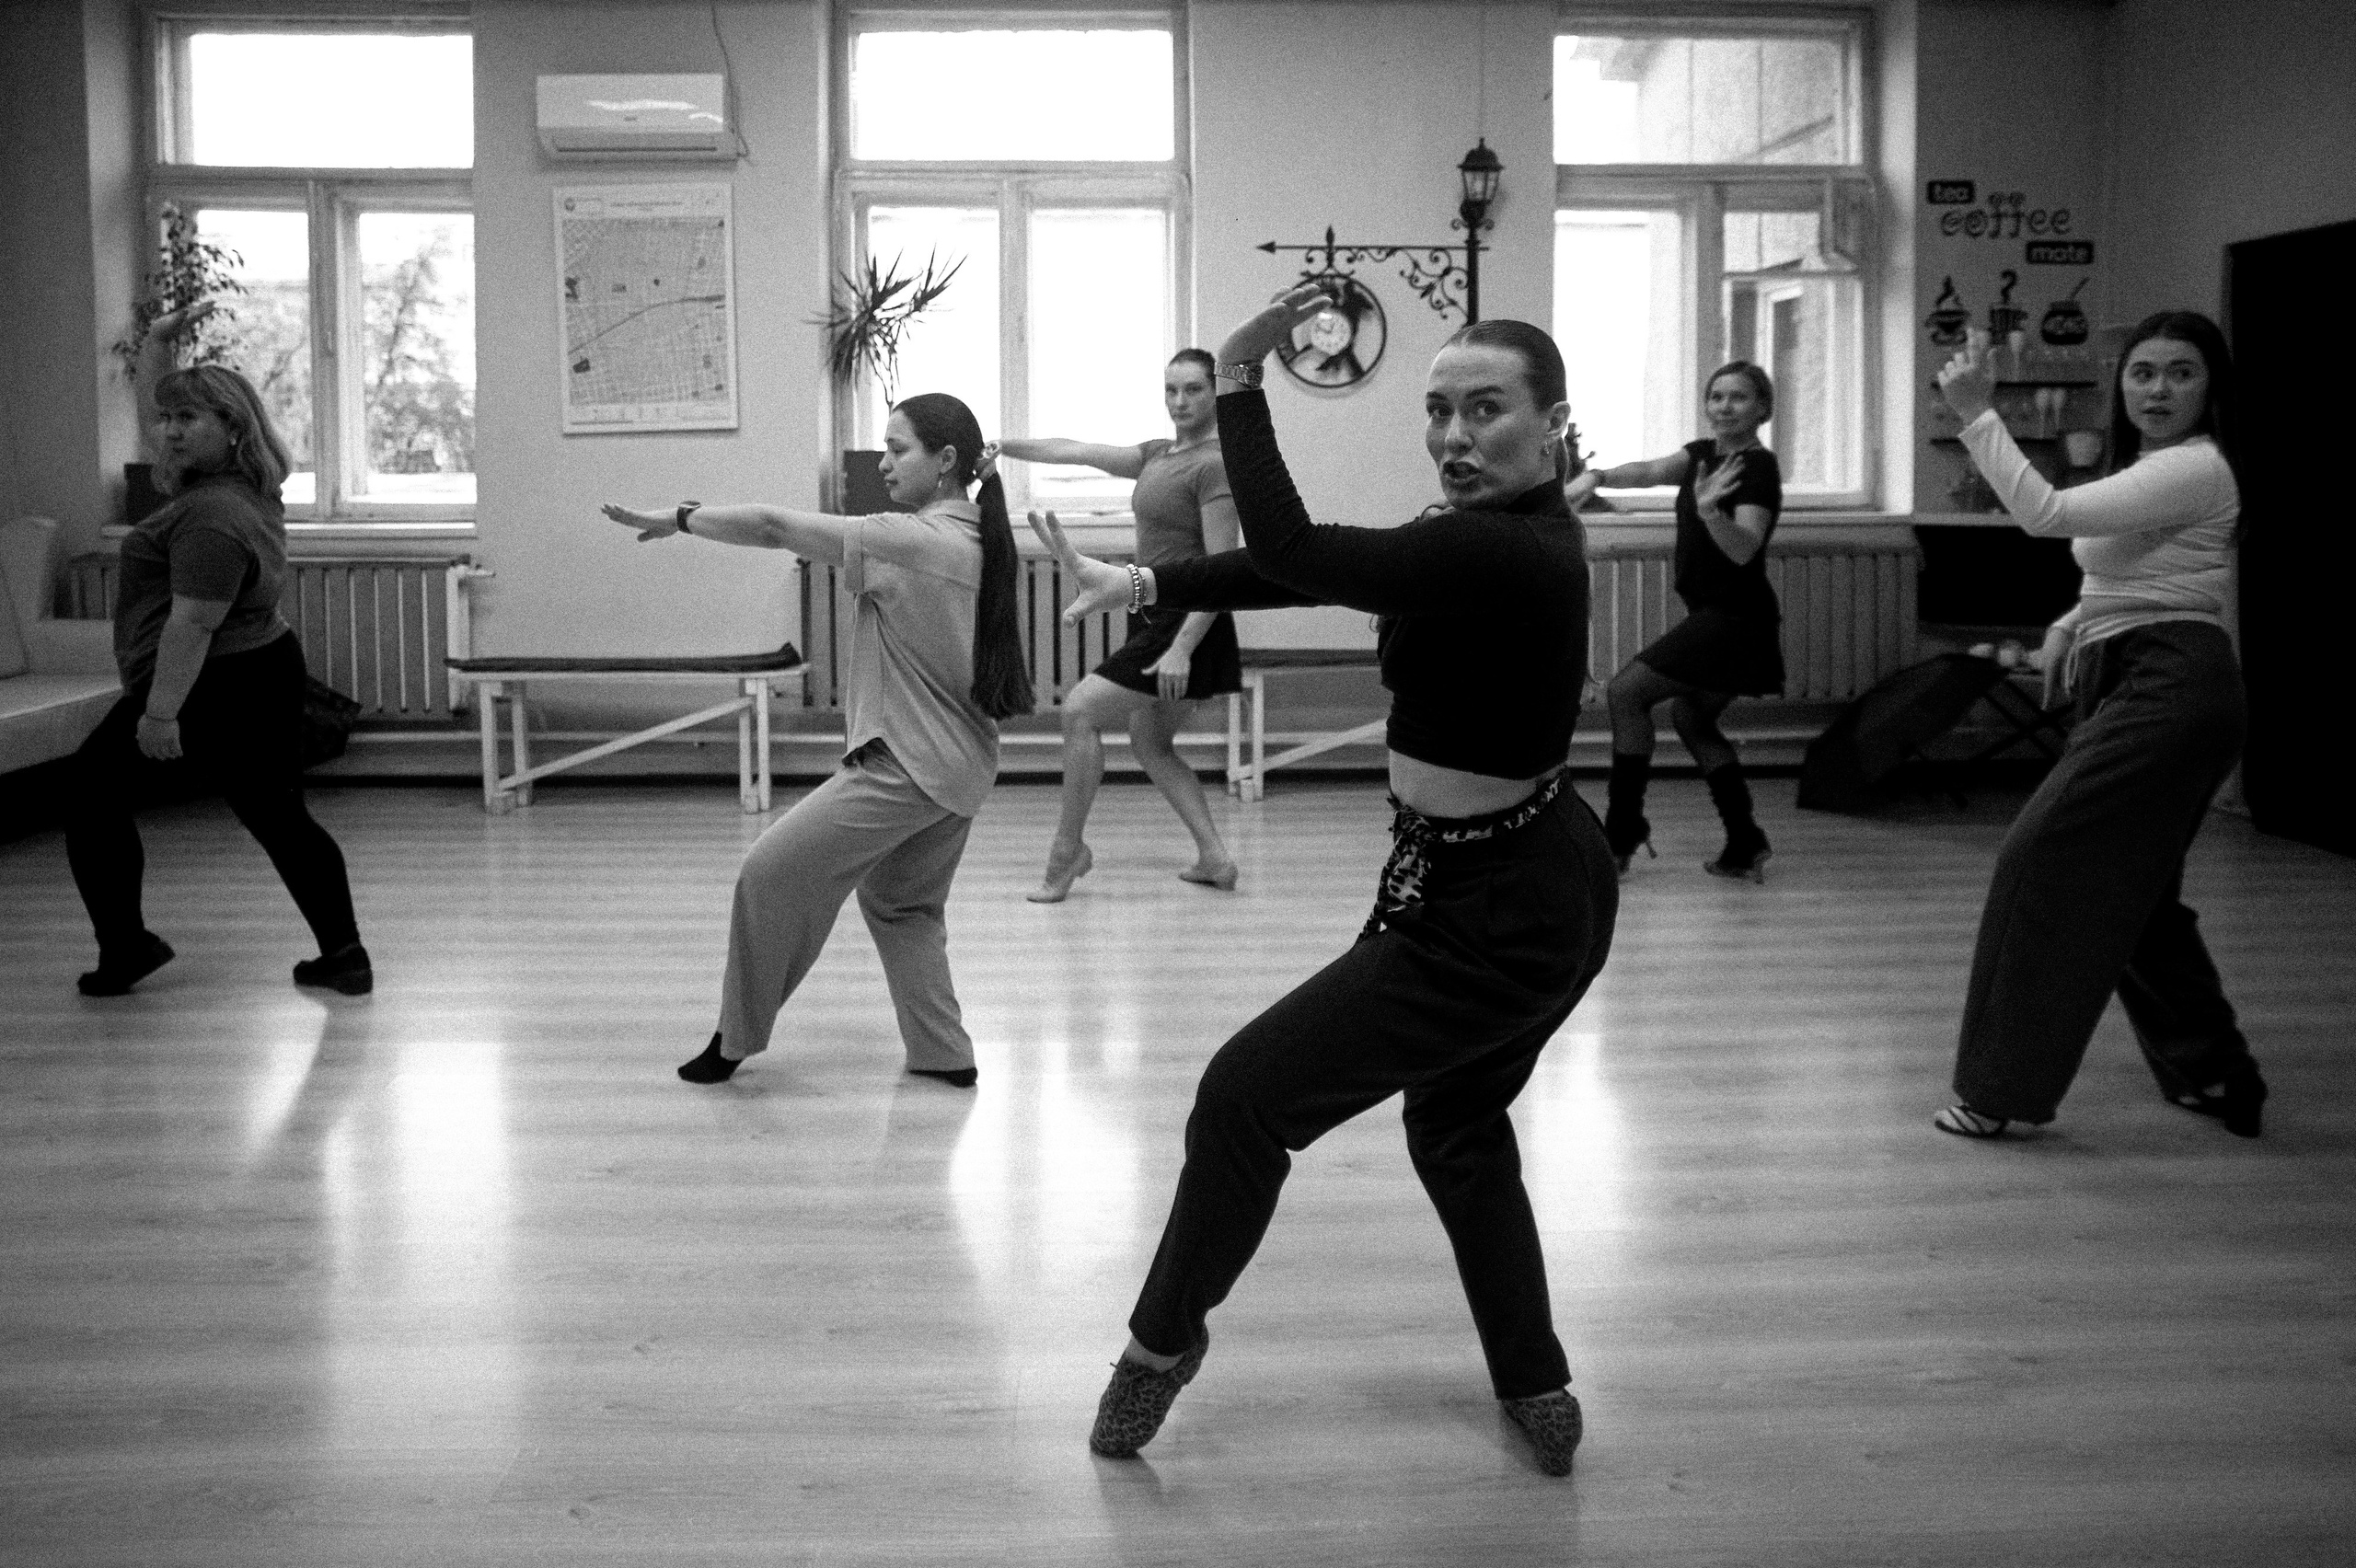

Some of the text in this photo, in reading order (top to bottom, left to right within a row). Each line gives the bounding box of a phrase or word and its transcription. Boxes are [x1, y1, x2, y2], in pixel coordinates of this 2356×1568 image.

[1934, 183, 1968, 201] tea
[1941, 191, 2073, 238] coffee
[2030, 245, 2088, 262] mate
